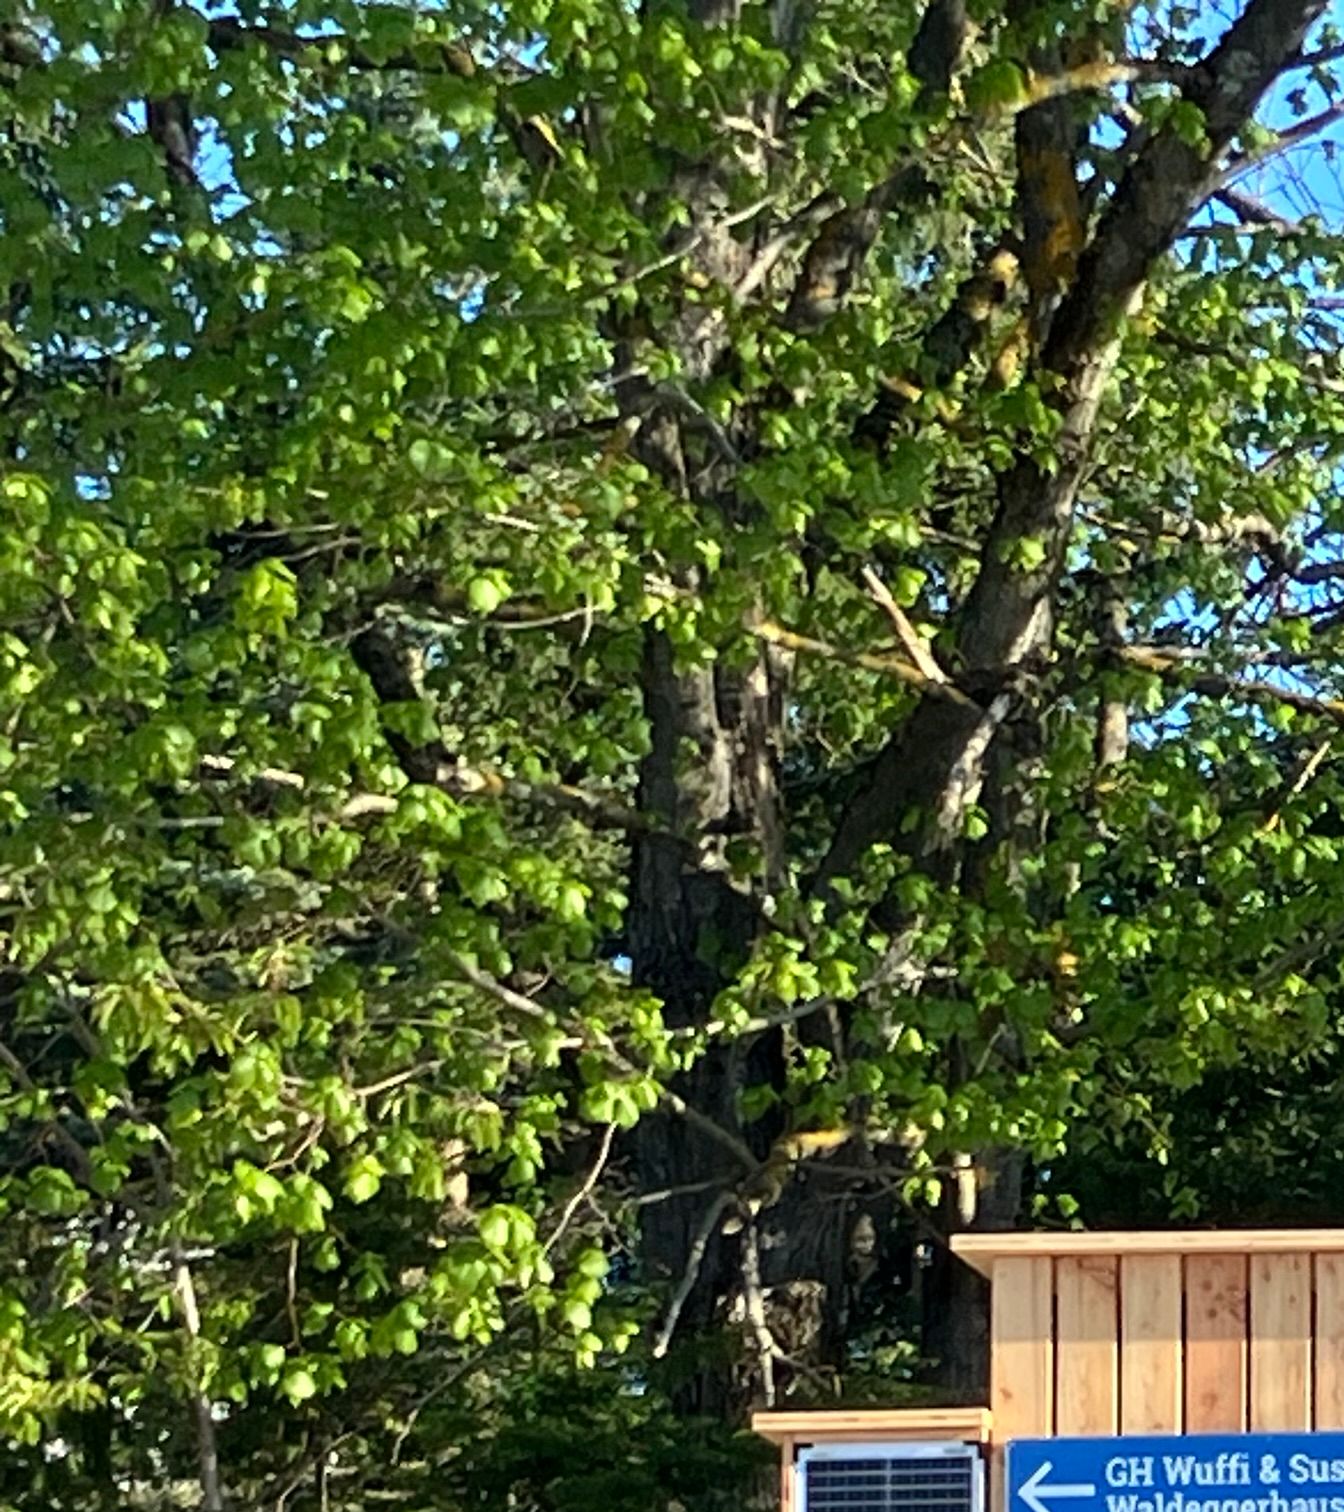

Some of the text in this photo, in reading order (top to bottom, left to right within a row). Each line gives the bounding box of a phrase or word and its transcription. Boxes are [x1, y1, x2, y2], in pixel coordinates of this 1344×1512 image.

[1106, 1456, 1153, 1487] GH
[1163, 1453, 1251, 1486] Wuffi
[1259, 1454, 1281, 1484] &
